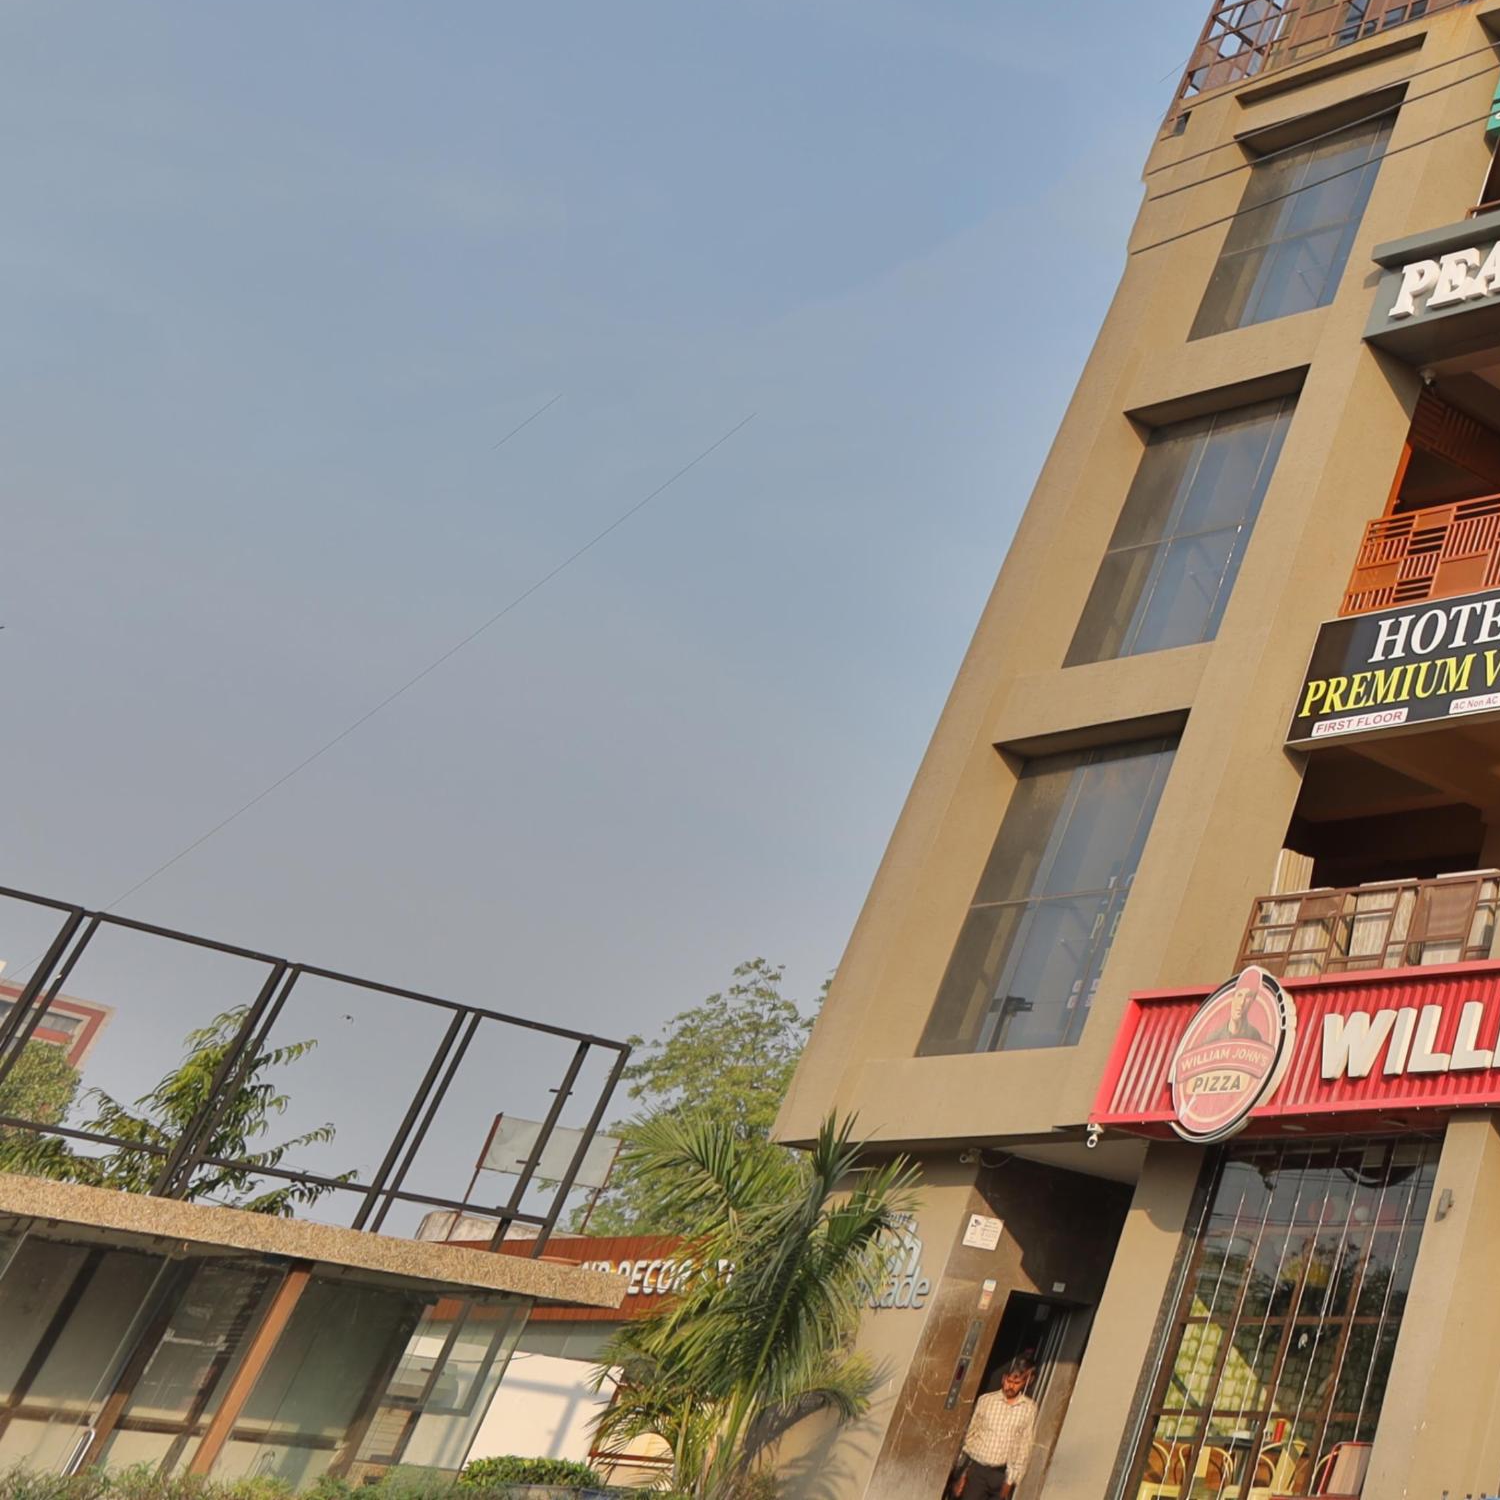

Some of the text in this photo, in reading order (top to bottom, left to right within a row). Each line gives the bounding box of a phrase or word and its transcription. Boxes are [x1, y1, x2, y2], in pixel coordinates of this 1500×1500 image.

[1298, 652, 1477, 719] PREMIUM
[1452, 701, 1467, 712] AC
[1467, 699, 1484, 710] Non
[1484, 696, 1500, 707] AC
[1315, 710, 1404, 735] FIRST FLOOR
[1181, 1049, 1269, 1072] WILLIAM JOHN'S
[1192, 1074, 1242, 1093] PIZZA
